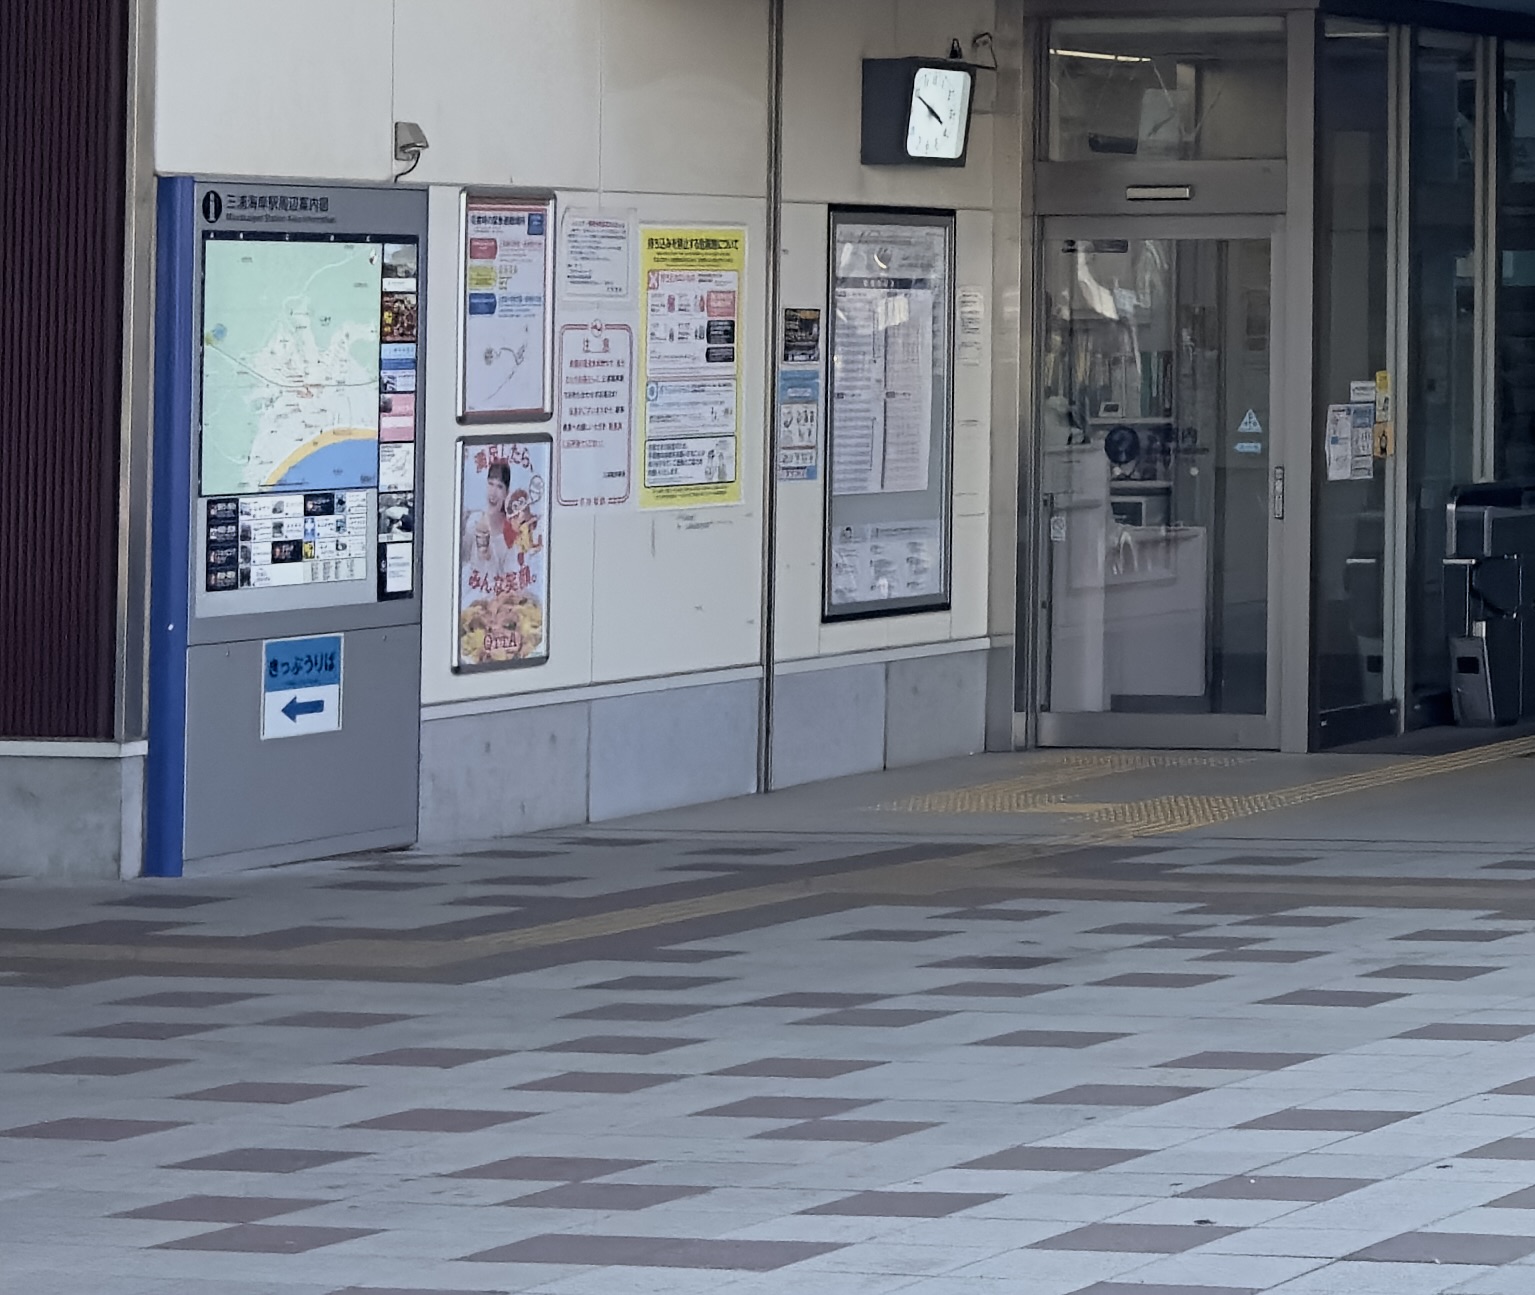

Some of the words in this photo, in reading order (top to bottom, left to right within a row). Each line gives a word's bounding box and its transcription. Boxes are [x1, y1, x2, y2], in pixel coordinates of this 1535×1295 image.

[268, 652, 336, 678] きっぷうりば
